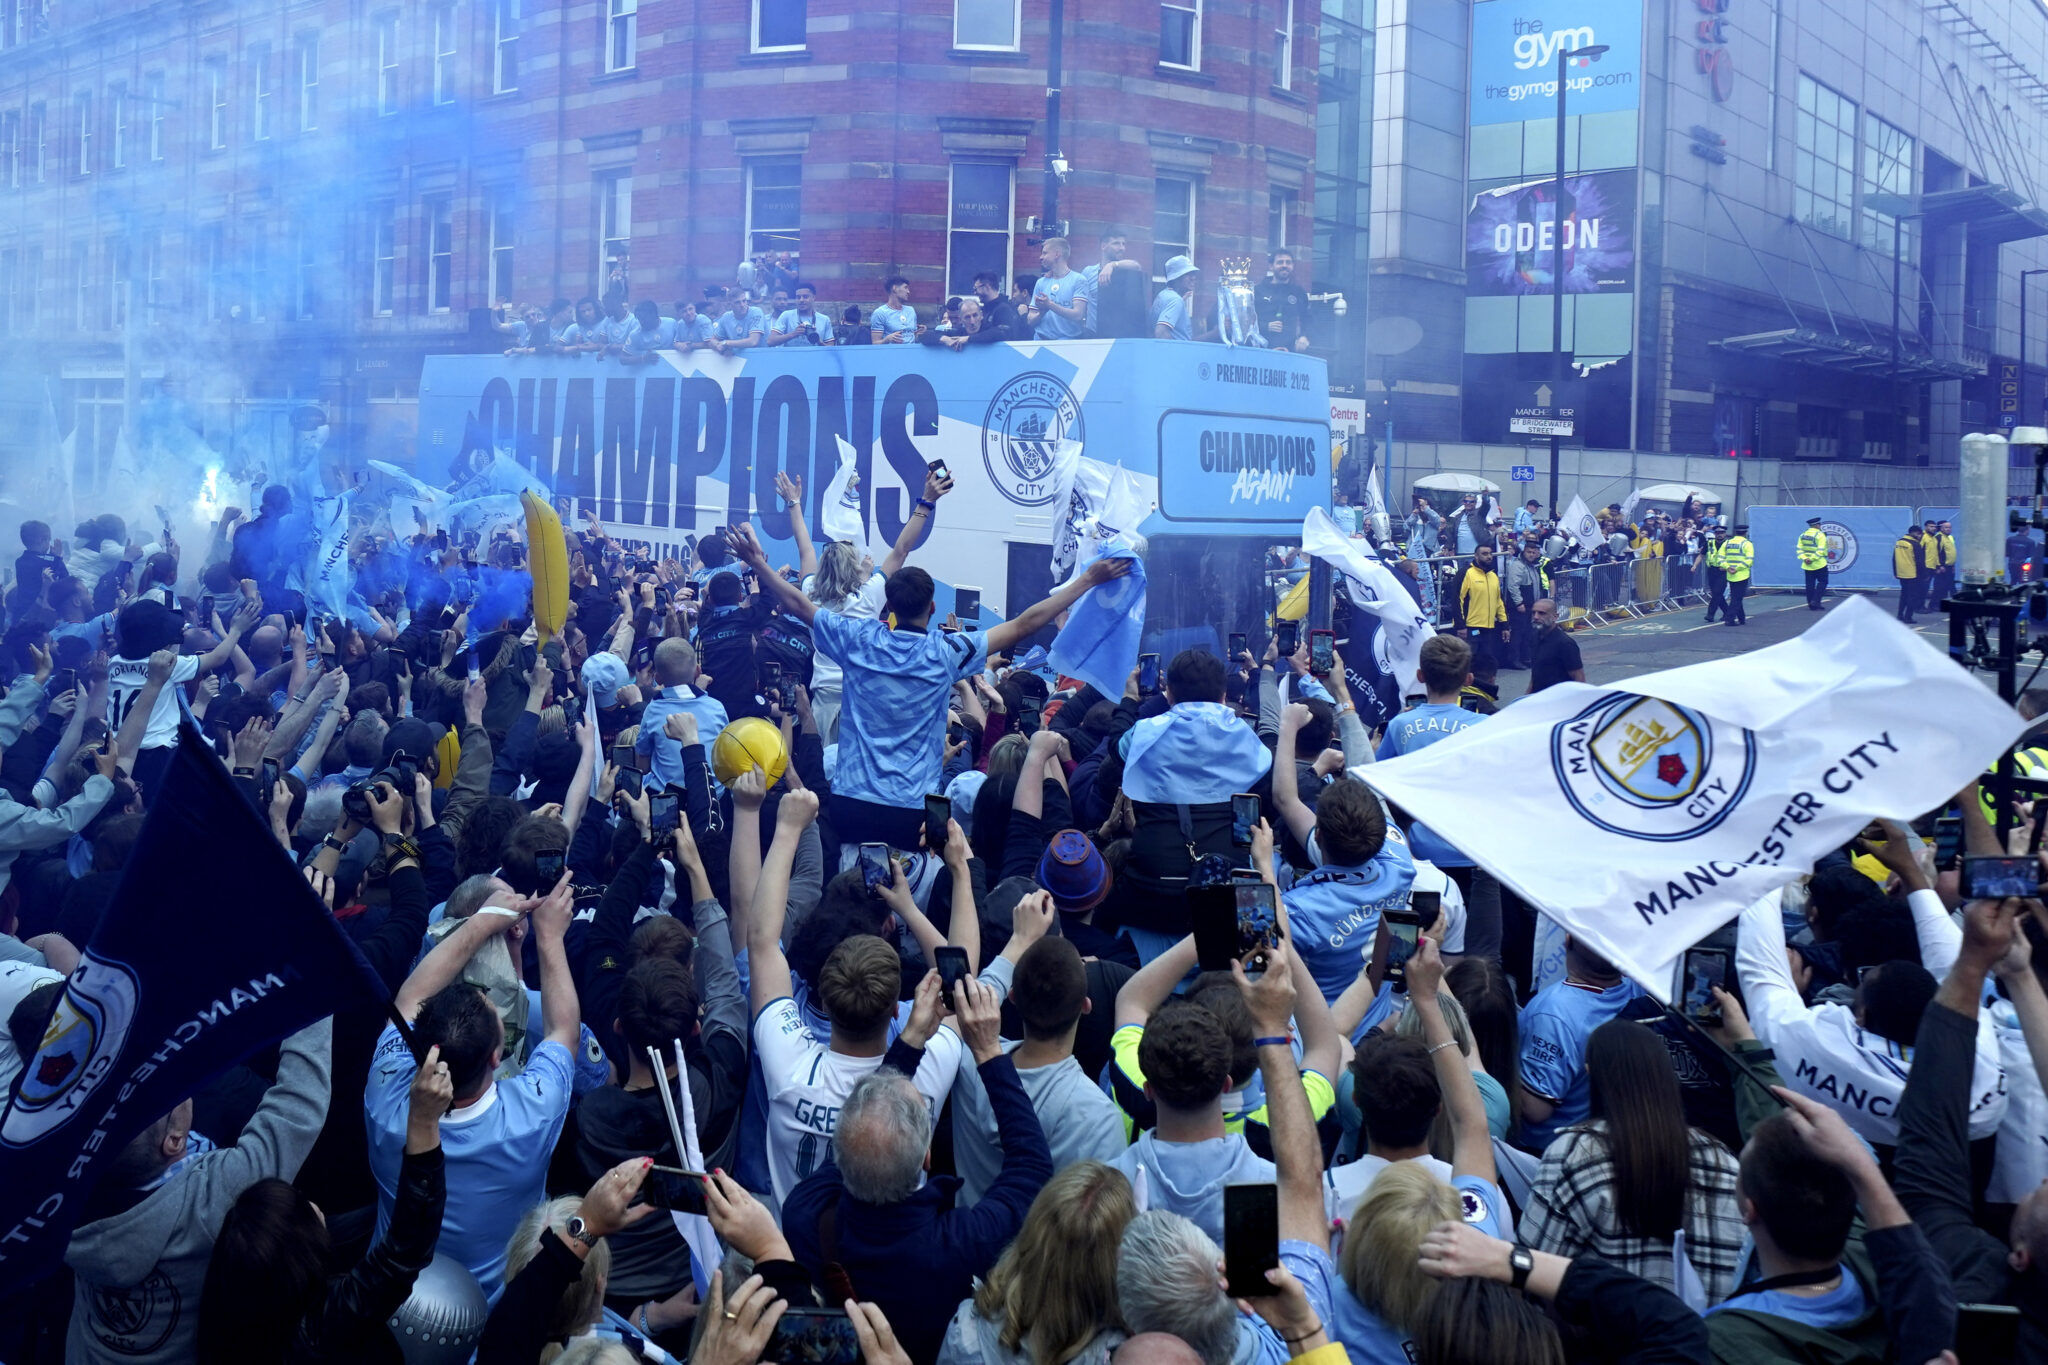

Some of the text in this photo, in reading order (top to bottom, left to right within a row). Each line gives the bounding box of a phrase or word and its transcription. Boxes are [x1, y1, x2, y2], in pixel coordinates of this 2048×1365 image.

[1513, 17, 1543, 36] the
[1513, 26, 1594, 70] gym
[1494, 218, 1600, 253] ODEON
[1216, 363, 1310, 391] PREMIER LEAGUE 21/22
[2003, 366, 2017, 410] NCP
[994, 382, 1074, 423] MANCHESTER
[1330, 406, 1358, 421] Centre
[1516, 408, 1574, 416] MANCHETER
[1522, 419, 1573, 428] BRIDGEWATER
[991, 434, 998, 442] 18
[1200, 430, 1316, 477] CHAMPIONS
[1016, 484, 1045, 496] CITY
[1230, 467, 1296, 505] AGAIN!
[1823, 731, 1899, 794] CITY
[1687, 777, 1728, 819] CITY
[1532, 1034, 1564, 1059] NEXEN
[1532, 1047, 1556, 1064] TIRE
[102, 1334, 136, 1348] CITY
